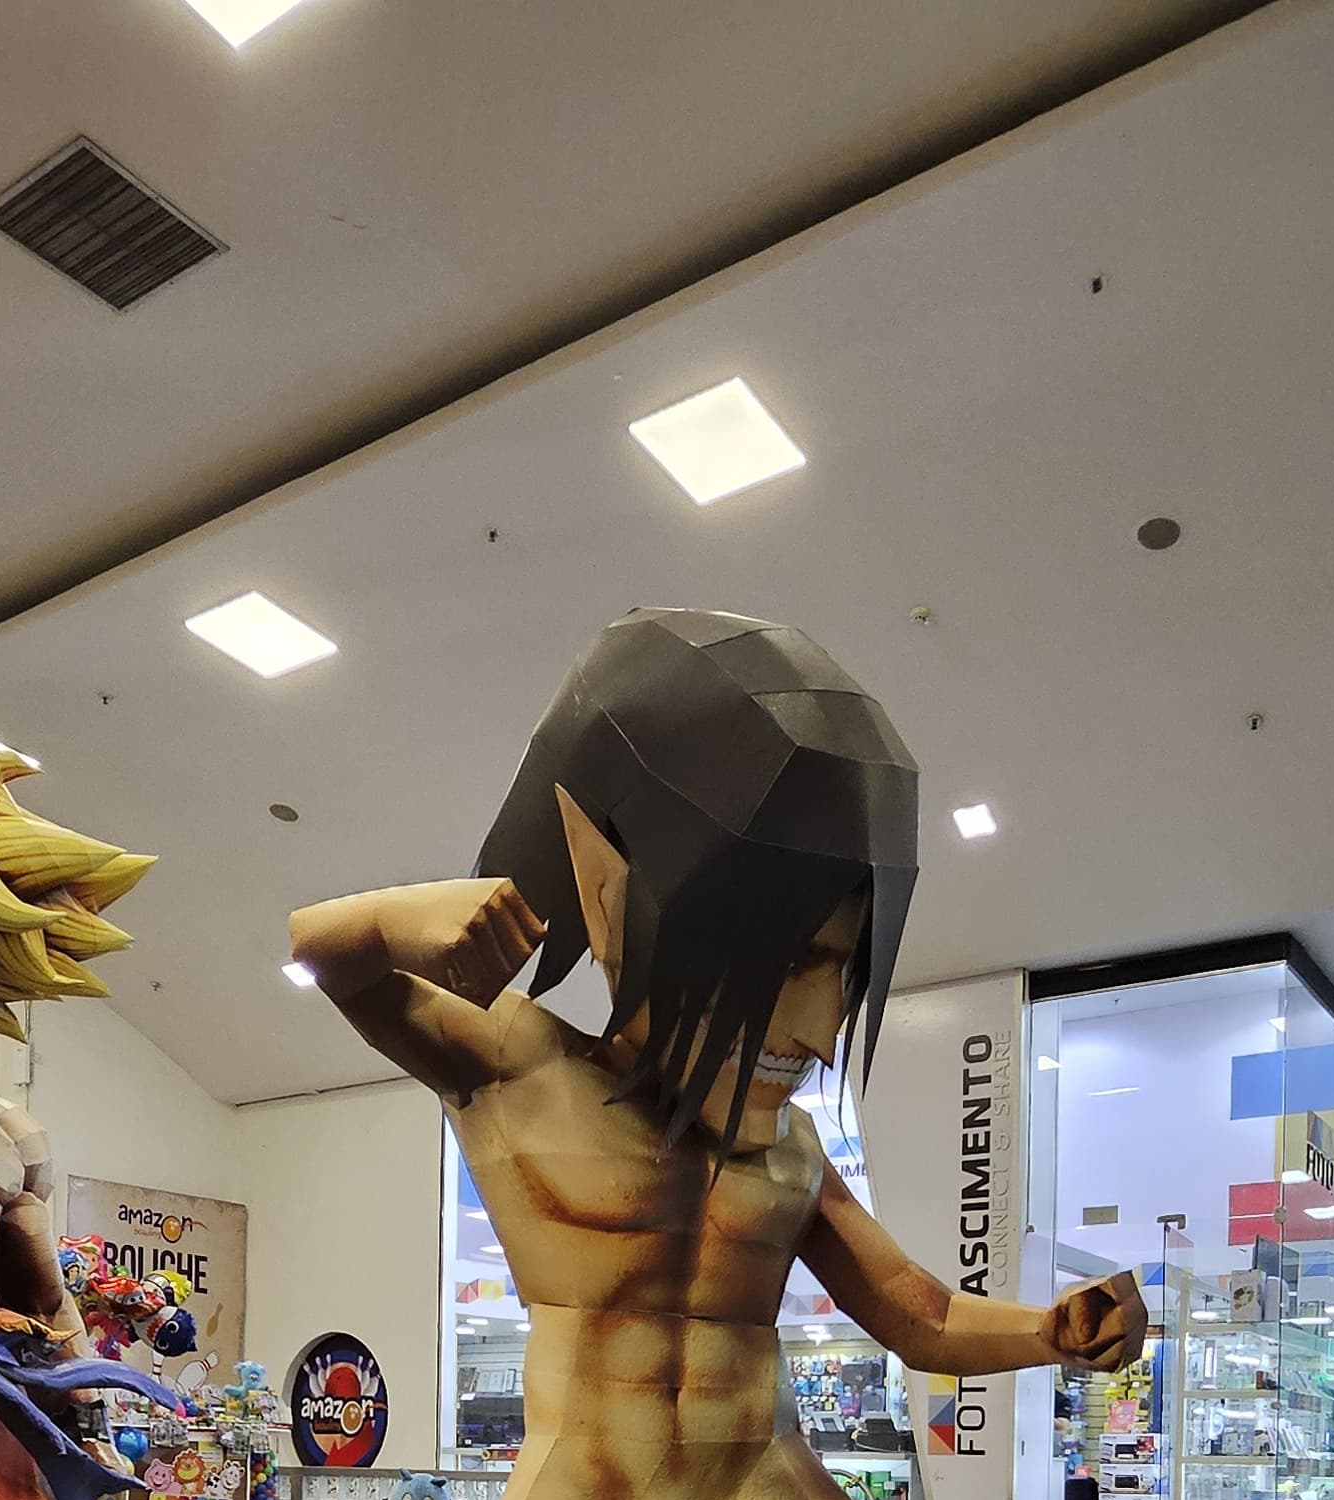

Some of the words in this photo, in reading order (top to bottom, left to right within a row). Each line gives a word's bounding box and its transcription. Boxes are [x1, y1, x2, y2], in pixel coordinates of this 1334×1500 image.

[994, 1029, 1012, 1117] SHARE
[959, 1034, 993, 1298] ASCIMENTO
[118, 1204, 194, 1243] amazon
[991, 1166, 1009, 1288] CONNECT
[301, 1397, 374, 1434] amazon
[957, 1376, 987, 1456] FOT
